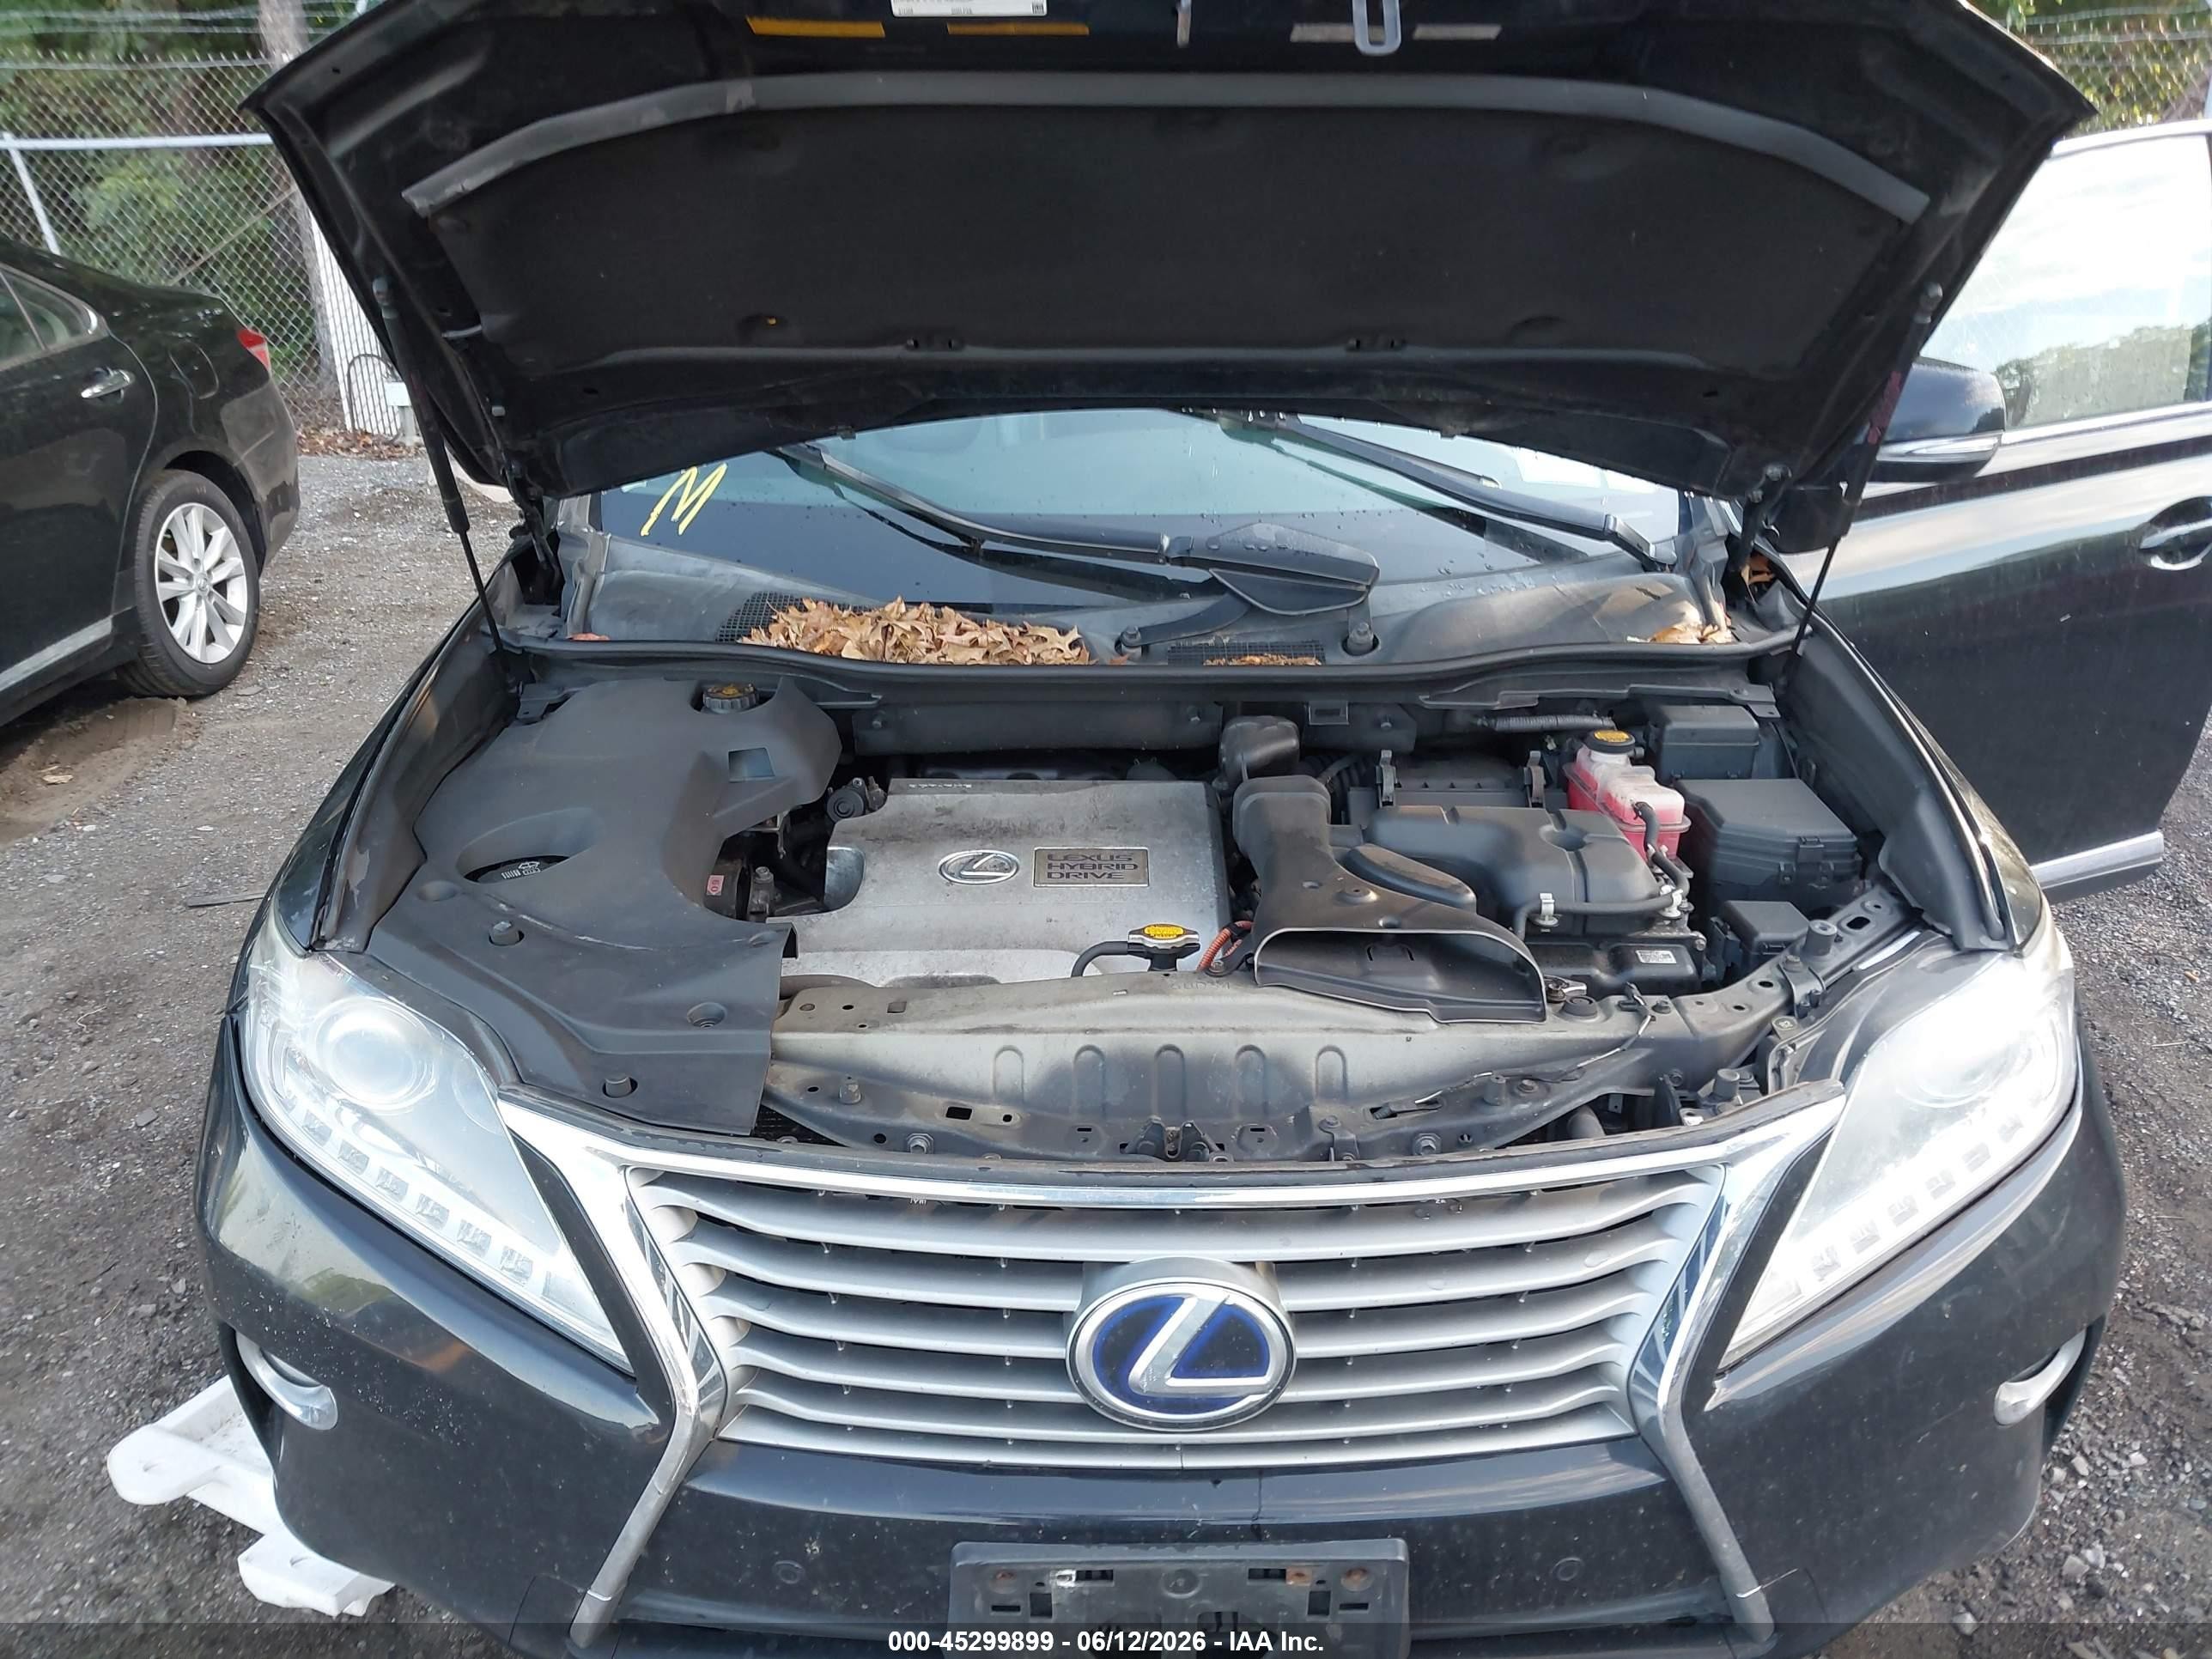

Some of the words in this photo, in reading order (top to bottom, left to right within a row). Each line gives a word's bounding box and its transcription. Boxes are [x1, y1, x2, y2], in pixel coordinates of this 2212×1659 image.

[640, 462, 728, 537] M
[1047, 854, 1134, 862] LEXUS
[1047, 862, 1139, 871] HYBRID
[1047, 872, 1125, 880] DRIVE
